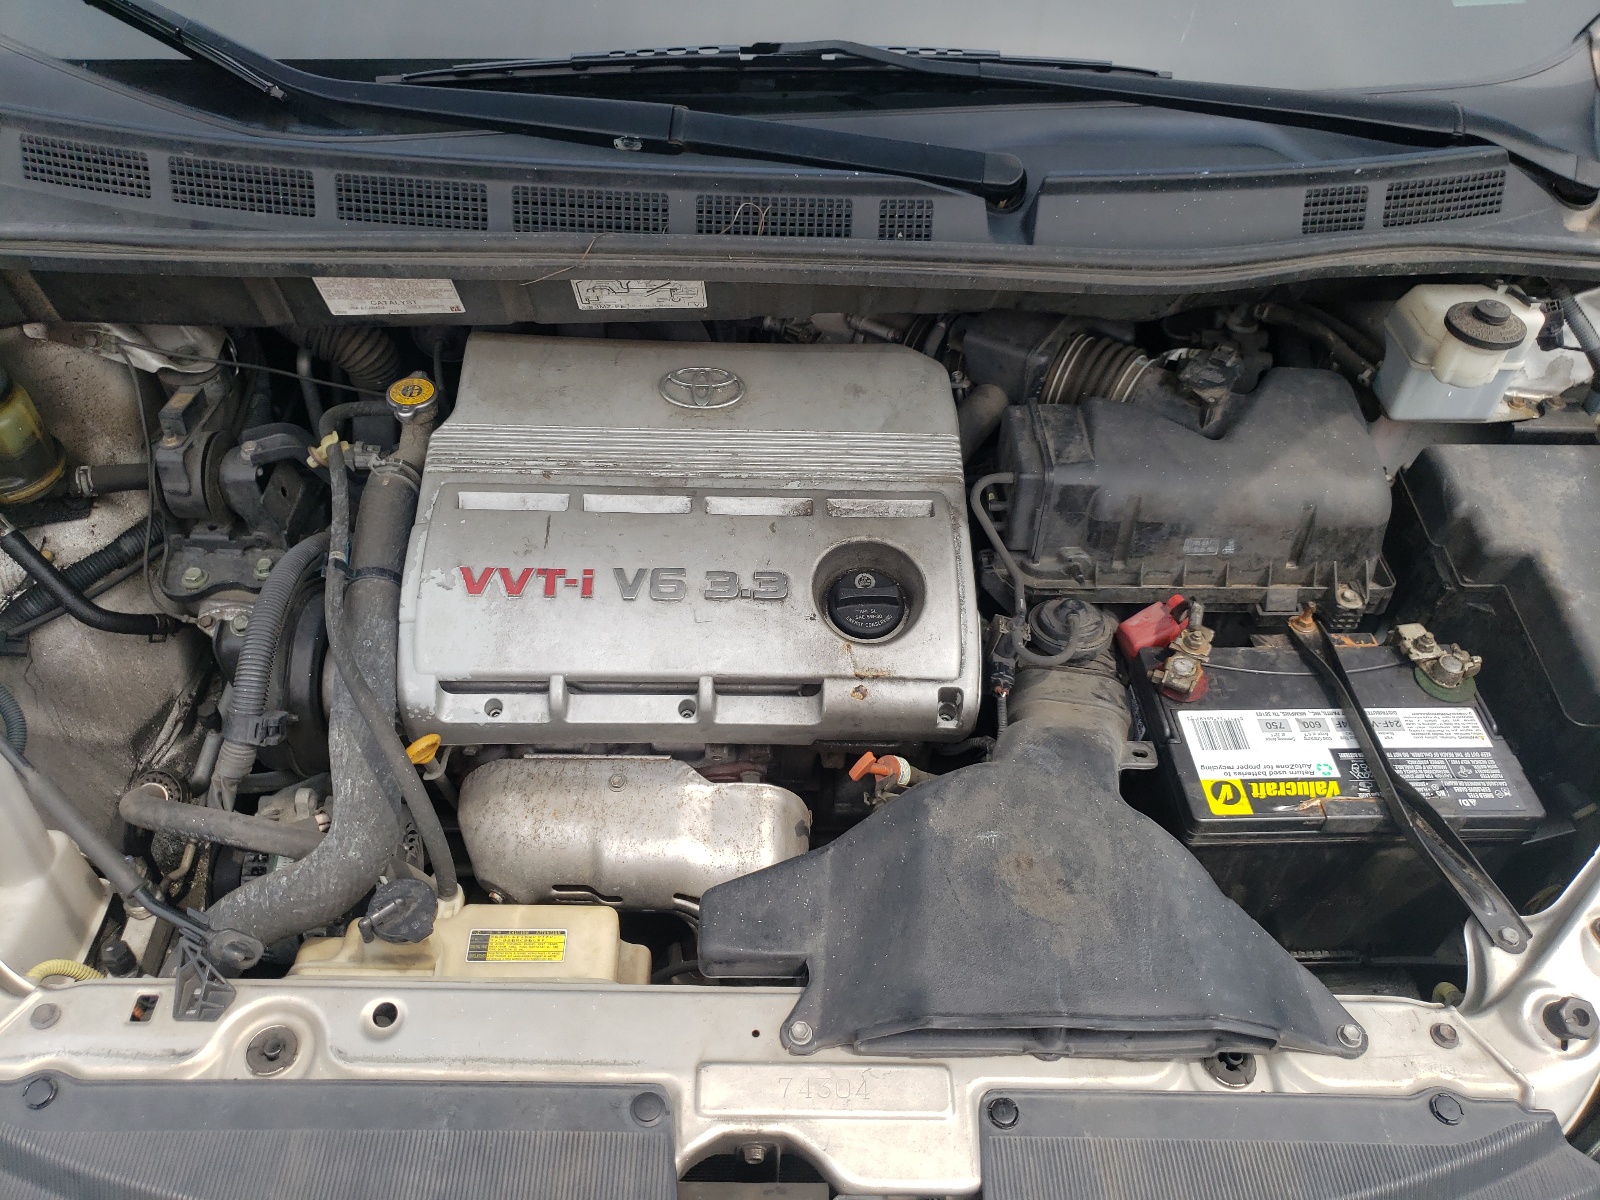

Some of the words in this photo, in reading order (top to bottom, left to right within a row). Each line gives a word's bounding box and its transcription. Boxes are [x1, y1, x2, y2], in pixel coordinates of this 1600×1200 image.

[458, 565, 595, 599] VVT-i
[613, 566, 687, 601] V6
[704, 569, 790, 600] 3.3
[1265, 721, 1285, 730] 750
[1303, 720, 1321, 729] 600
[1371, 720, 1401, 728] 24F-V
[1249, 780, 1341, 799] Valucraft
[778, 1076, 870, 1100] 74304
